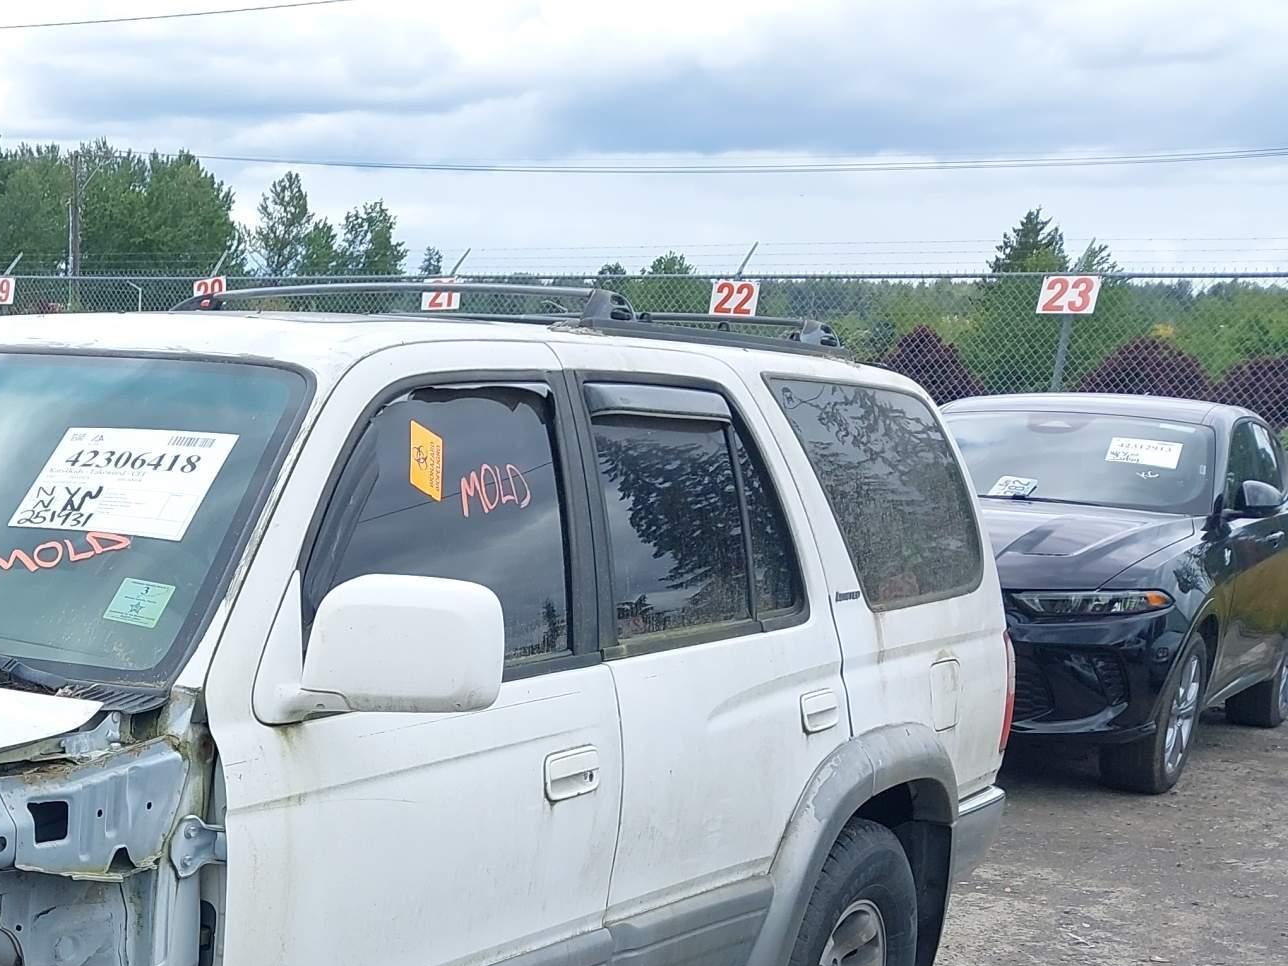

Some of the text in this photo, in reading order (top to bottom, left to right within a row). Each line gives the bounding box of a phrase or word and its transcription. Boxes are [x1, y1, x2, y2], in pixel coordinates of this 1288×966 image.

[428, 279, 455, 308] 21
[713, 282, 754, 315] 22
[1042, 277, 1095, 312] 23
[66, 449, 201, 473] 42306418
[461, 463, 531, 518] MOLD
